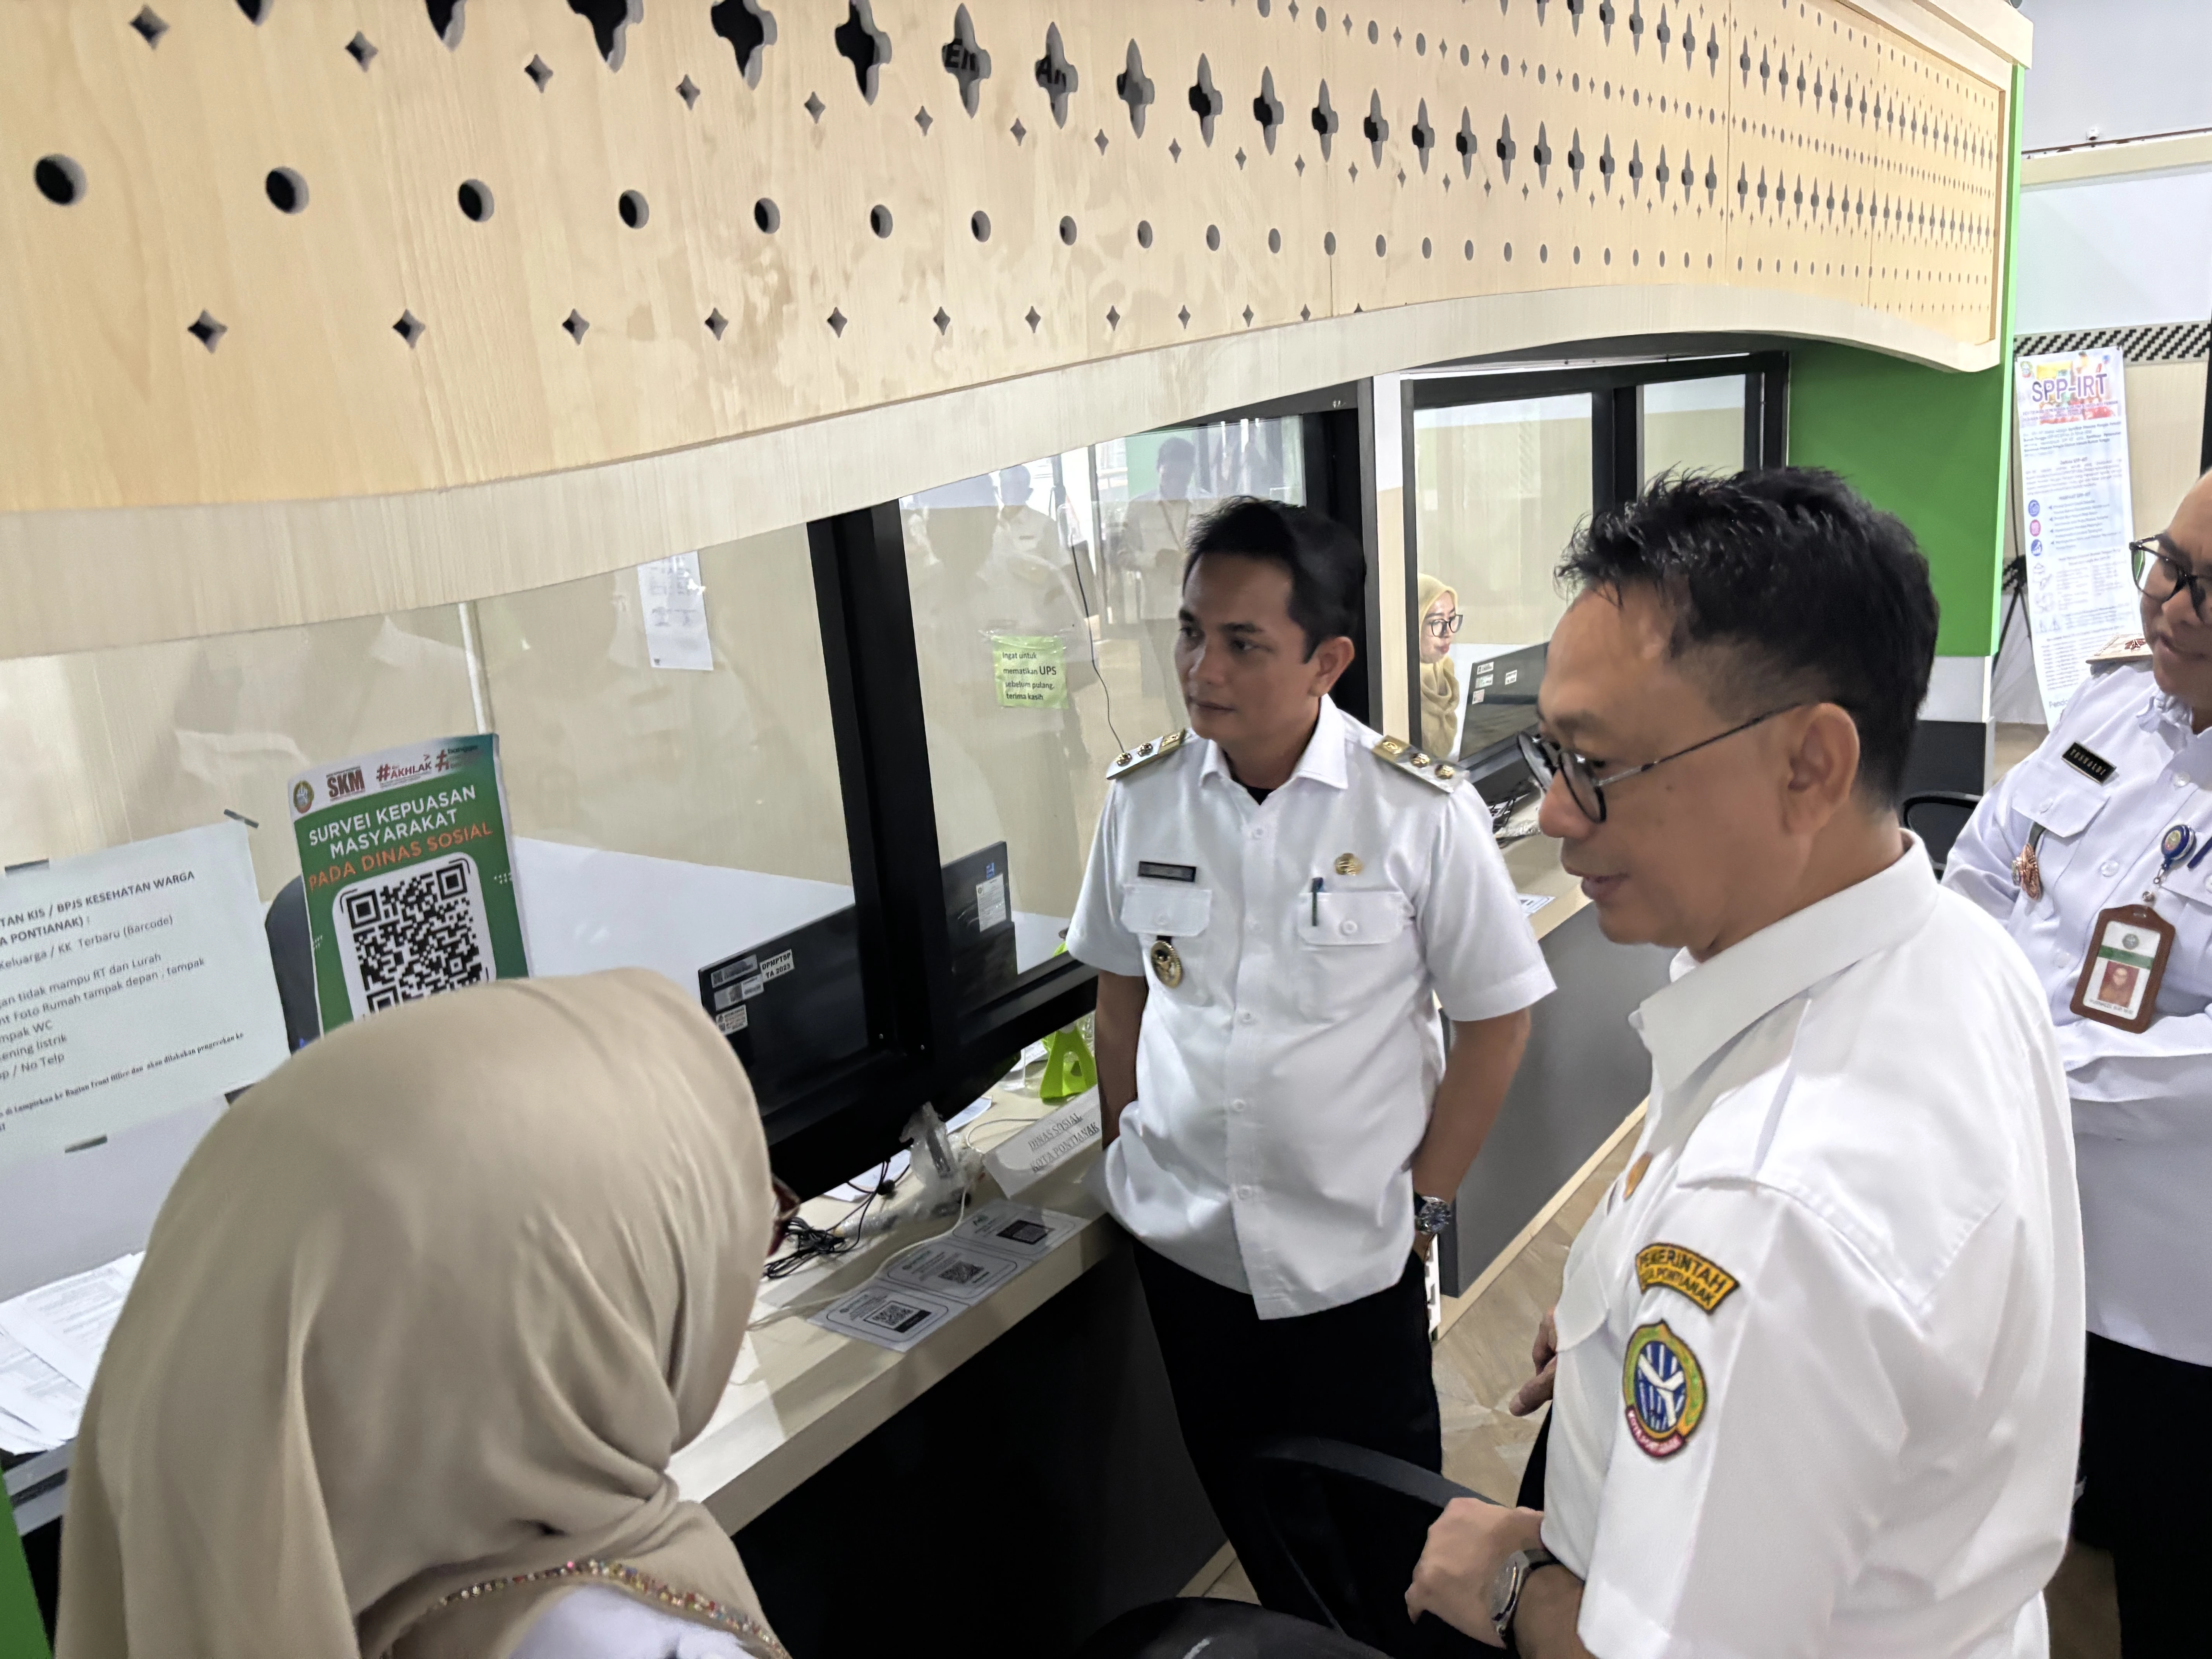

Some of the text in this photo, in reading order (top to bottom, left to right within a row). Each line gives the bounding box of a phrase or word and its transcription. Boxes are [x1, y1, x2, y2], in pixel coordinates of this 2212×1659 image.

[2032, 373, 2107, 402] SPP-IRT
[1039, 666, 1056, 675] UPS
[327, 770, 365, 798] SKM
[309, 785, 476, 846] SURVEI KEPUASAN
[330, 809, 458, 859] MASYARAKAT
[309, 821, 493, 891] PADA DINAS SOSIAL
[27, 908, 45, 921] KIS
[57, 898, 82, 913] BPJS
[86, 882, 151, 905] KESEHATAN
[153, 871, 194, 889] WARGA
[11, 916, 83, 943] PONTIANAK)
[58, 941, 72, 954] KK
[78, 931, 120, 948] Terbaru
[123, 914, 173, 938] (Barcode)
[14, 1008, 40, 1021] Foto
[43, 994, 81, 1012] Rumah
[84, 981, 123, 1000] tampak
[126, 972, 158, 987] depan
[167, 958, 204, 975] tampak
[19, 987, 45, 1002] tidak
[50, 974, 90, 992] mampu
[93, 967, 105, 979] RT
[110, 963, 129, 975] dan
[132, 953, 161, 968] Lurah
[33, 1020, 52, 1033] WC
[0, 1034, 67, 1061] ening listrik
[21, 1063, 37, 1072] No
[40, 1053, 64, 1068] Telp
[1028, 1113, 1083, 1152] DINAS SOSIAL
[1030, 1122, 1100, 1173] KOTA PONTIANAK
